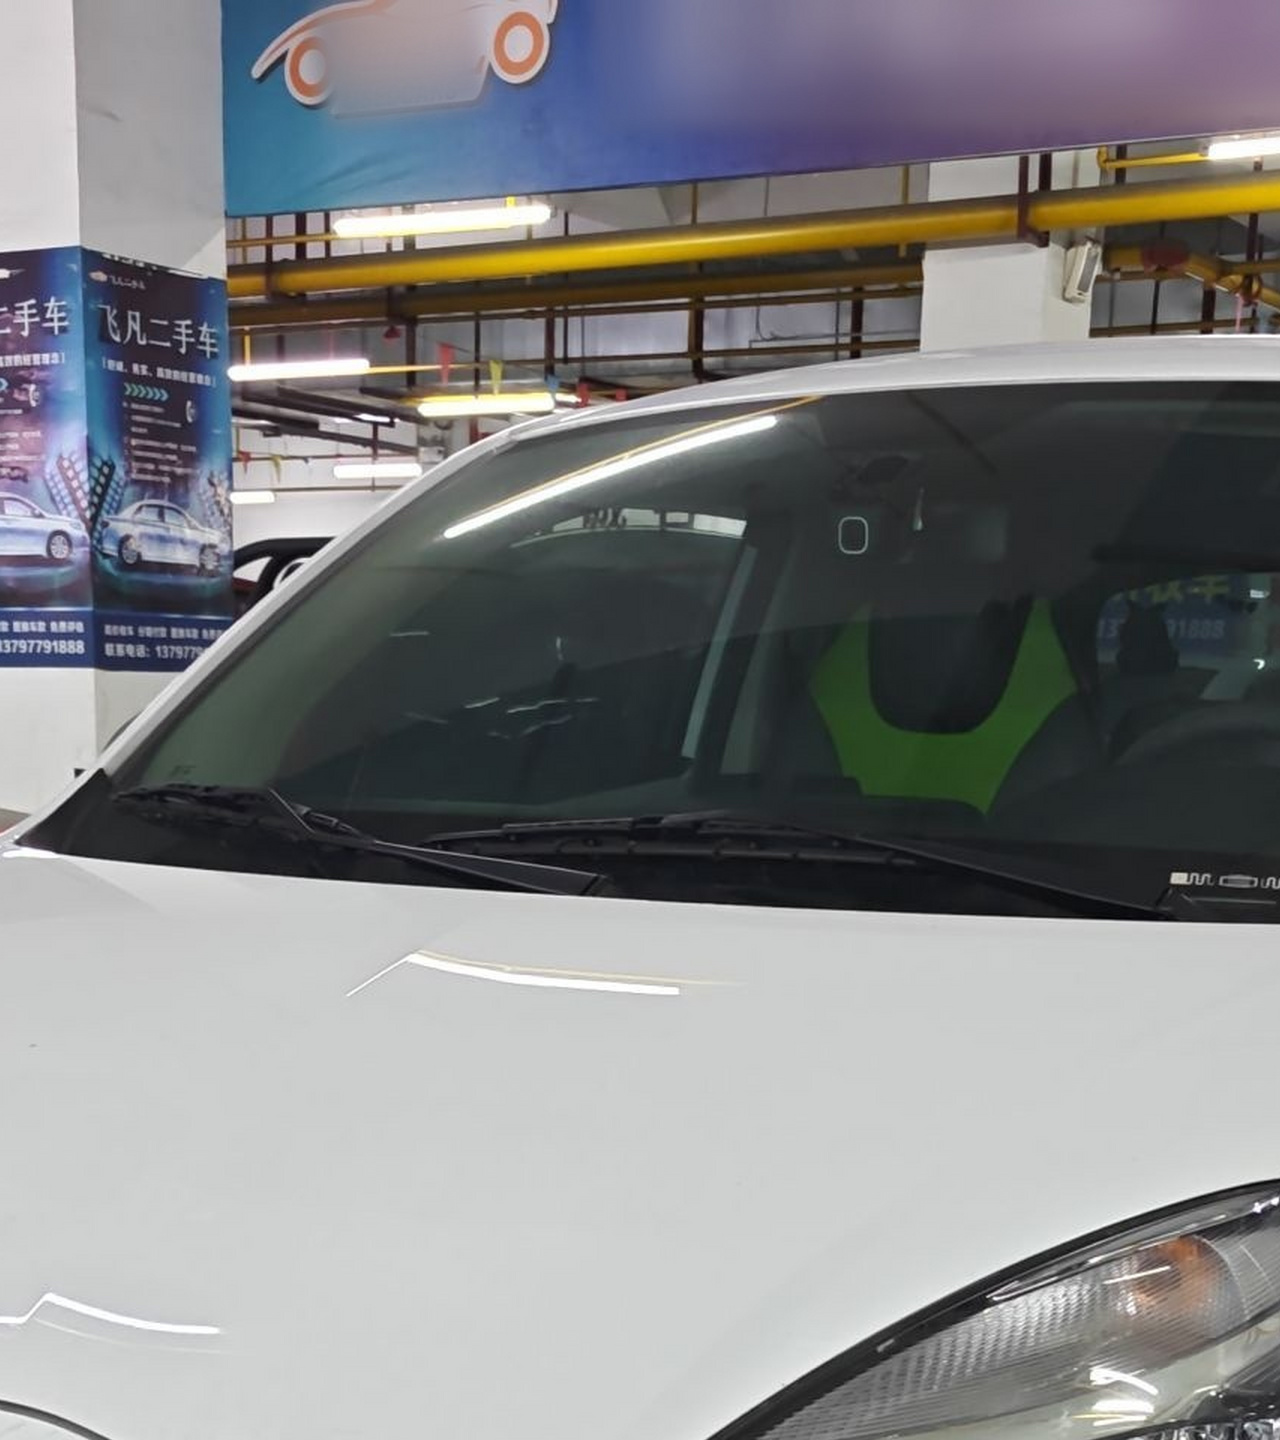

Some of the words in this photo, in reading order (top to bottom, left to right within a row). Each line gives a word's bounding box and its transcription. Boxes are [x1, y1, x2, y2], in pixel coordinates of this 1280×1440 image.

[96, 304, 220, 359] 飞凡二手车
[154, 645, 209, 660] 1379779
